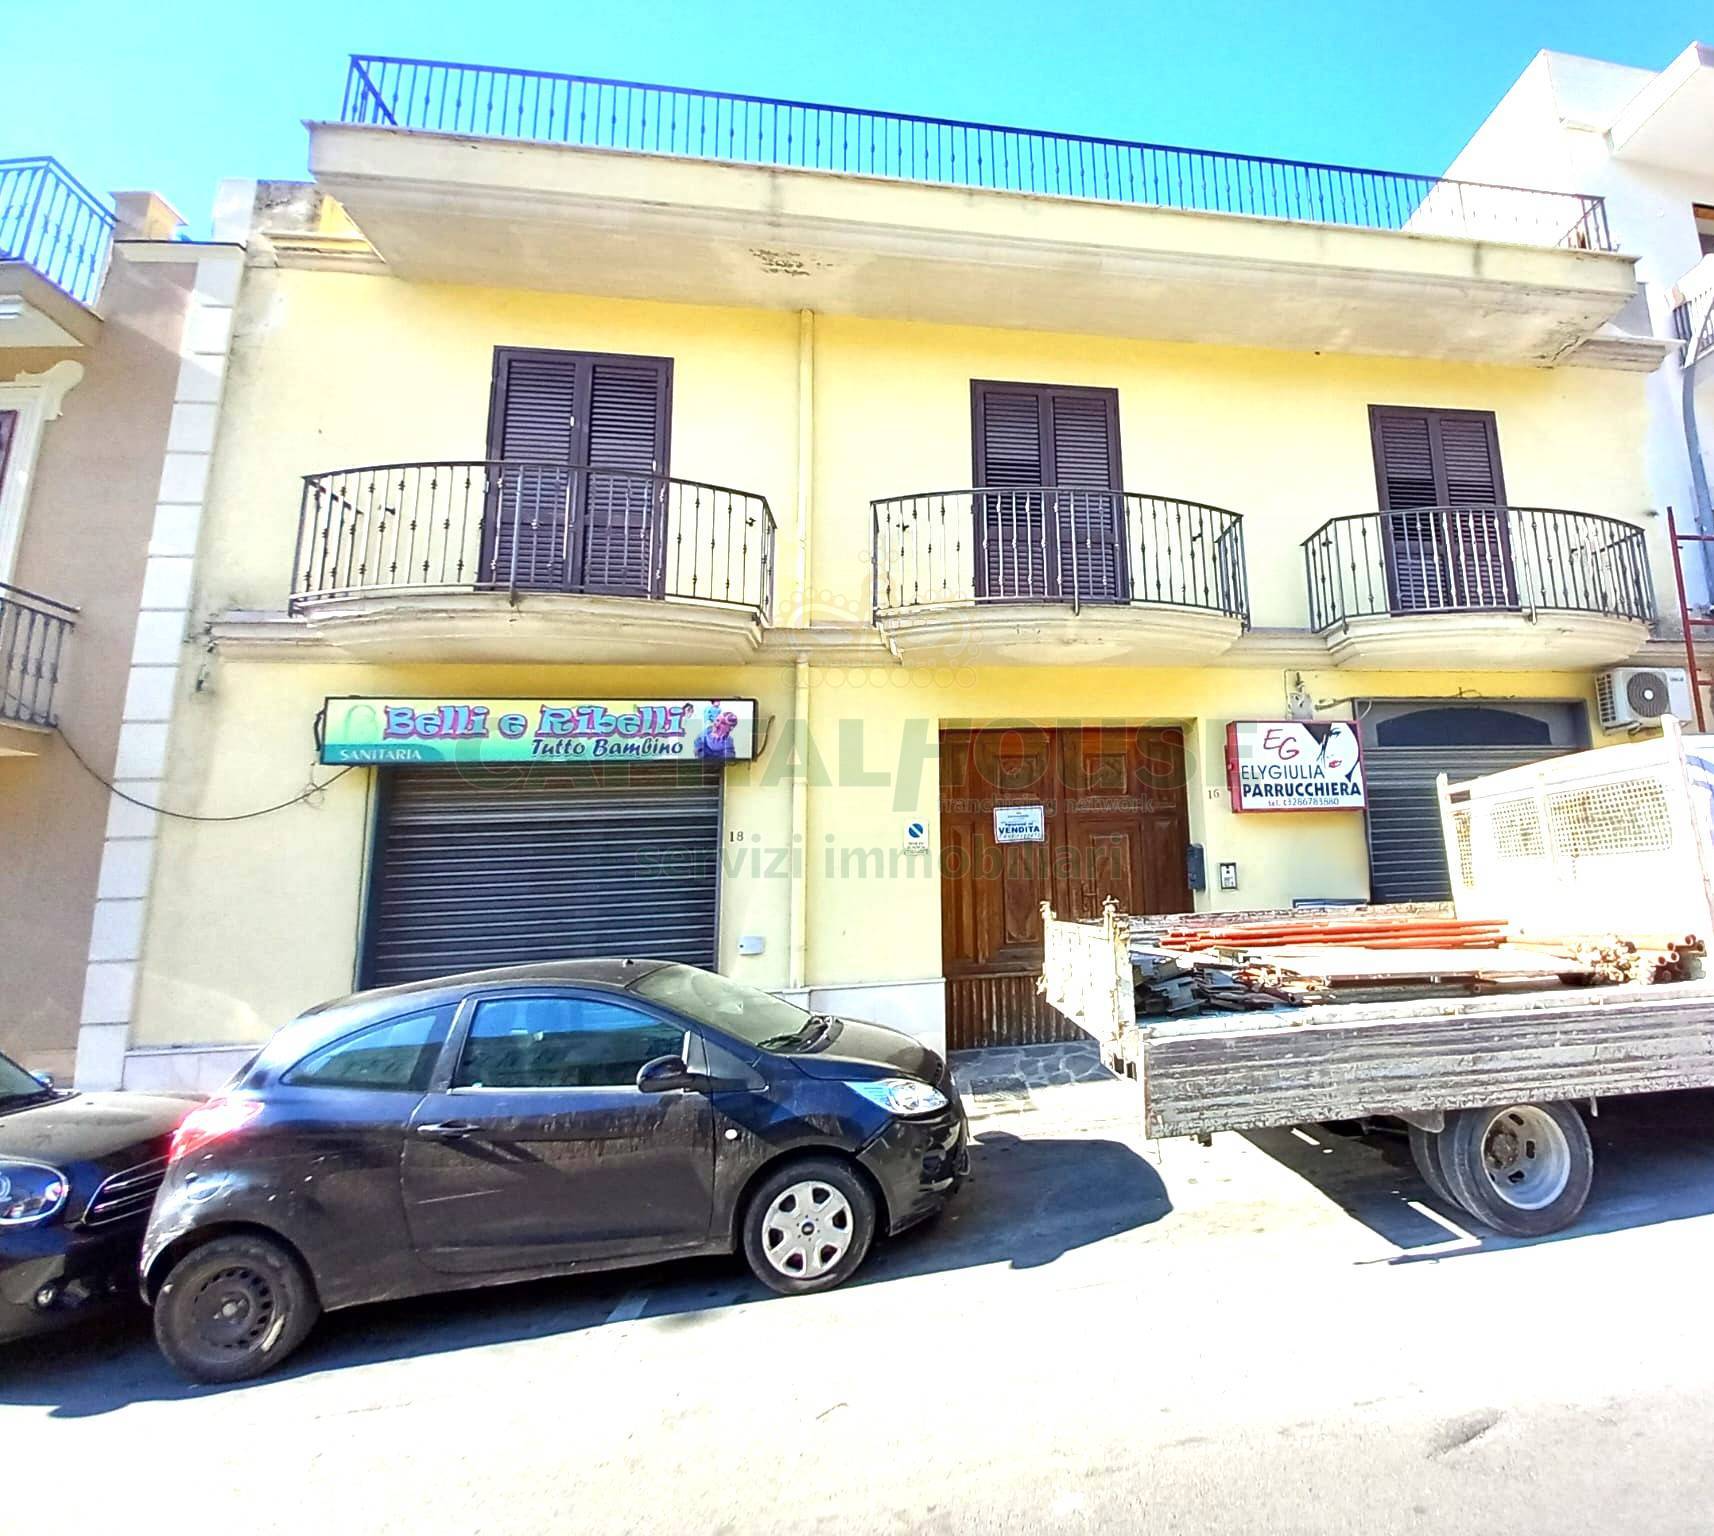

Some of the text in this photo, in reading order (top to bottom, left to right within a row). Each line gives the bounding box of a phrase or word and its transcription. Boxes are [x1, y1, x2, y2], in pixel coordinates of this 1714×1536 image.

[384, 704, 687, 739] Belli e Ribelli
[532, 738, 683, 757] Tutto Bambino
[1263, 728, 1300, 760] EG
[340, 748, 423, 762] SANITARIA
[1241, 764, 1326, 780] ELYGIULIA
[1243, 781, 1362, 798] PARRUCCHIERA
[729, 831, 744, 843] 18
[998, 825, 1040, 834] VENDITA
